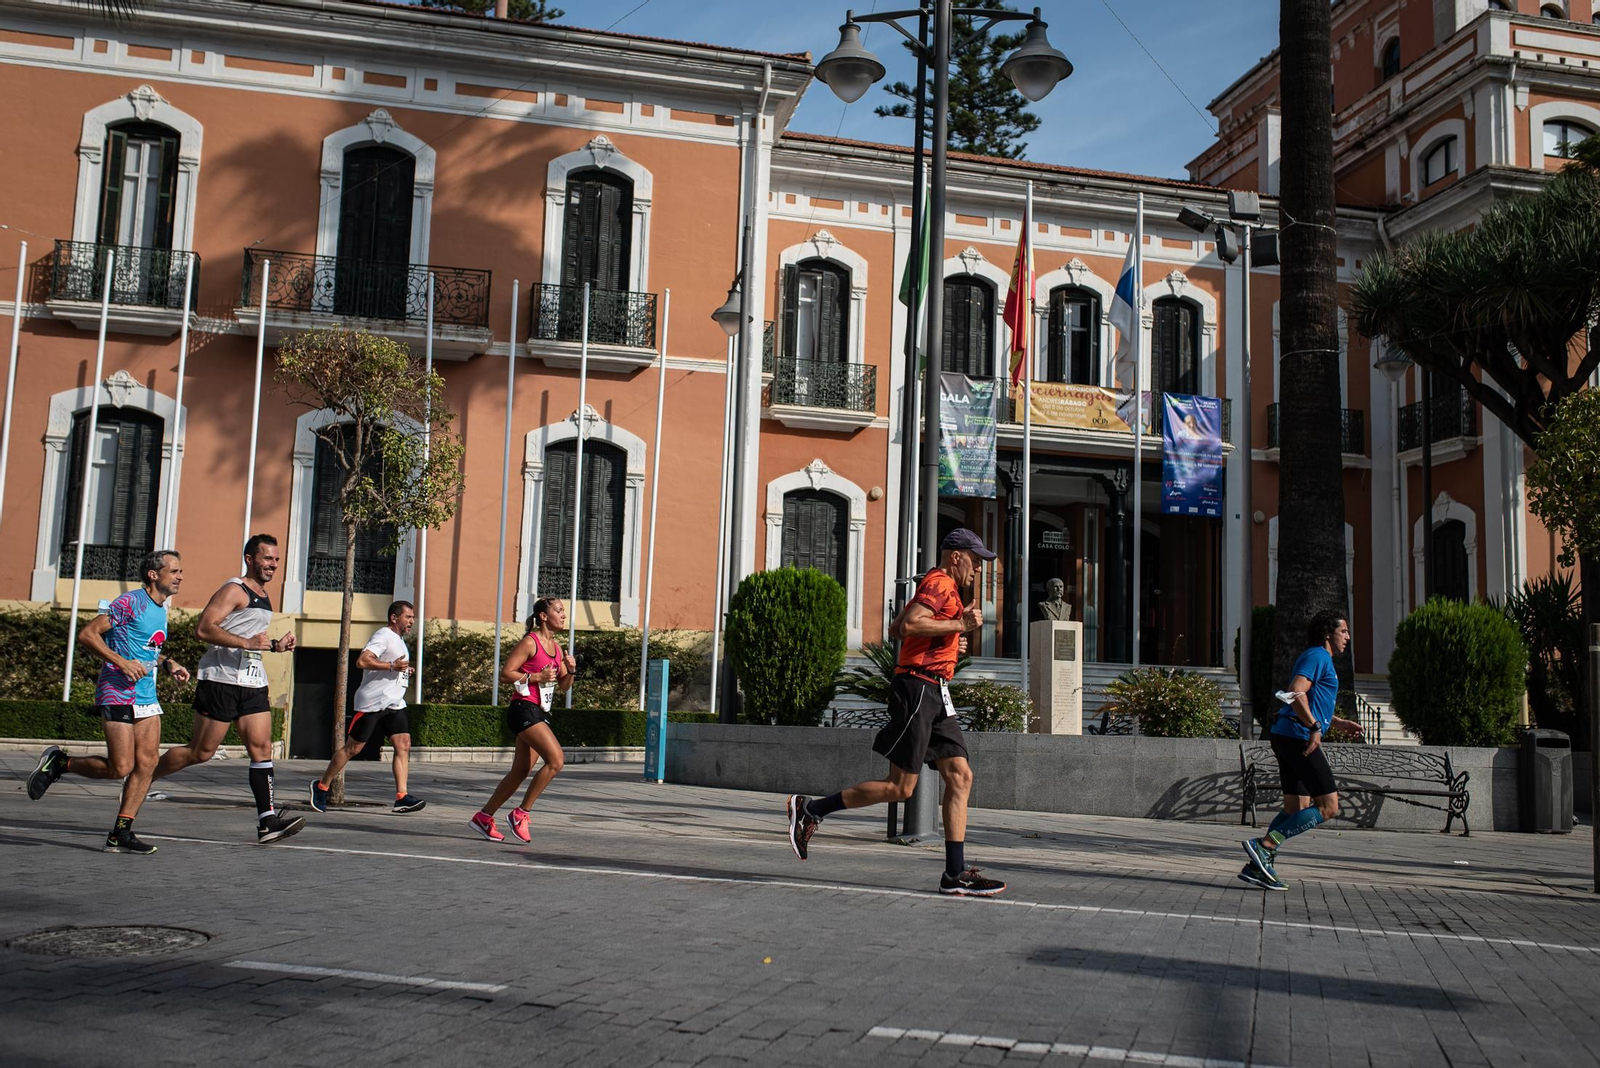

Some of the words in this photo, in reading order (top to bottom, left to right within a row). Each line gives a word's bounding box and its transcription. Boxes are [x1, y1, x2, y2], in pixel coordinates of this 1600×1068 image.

[1065, 385, 1099, 393] EXPOSICIÓN
[940, 392, 970, 404] GALA
[1059, 398, 1087, 407] RÁBAGO
[1037, 542, 1054, 550] CASA
